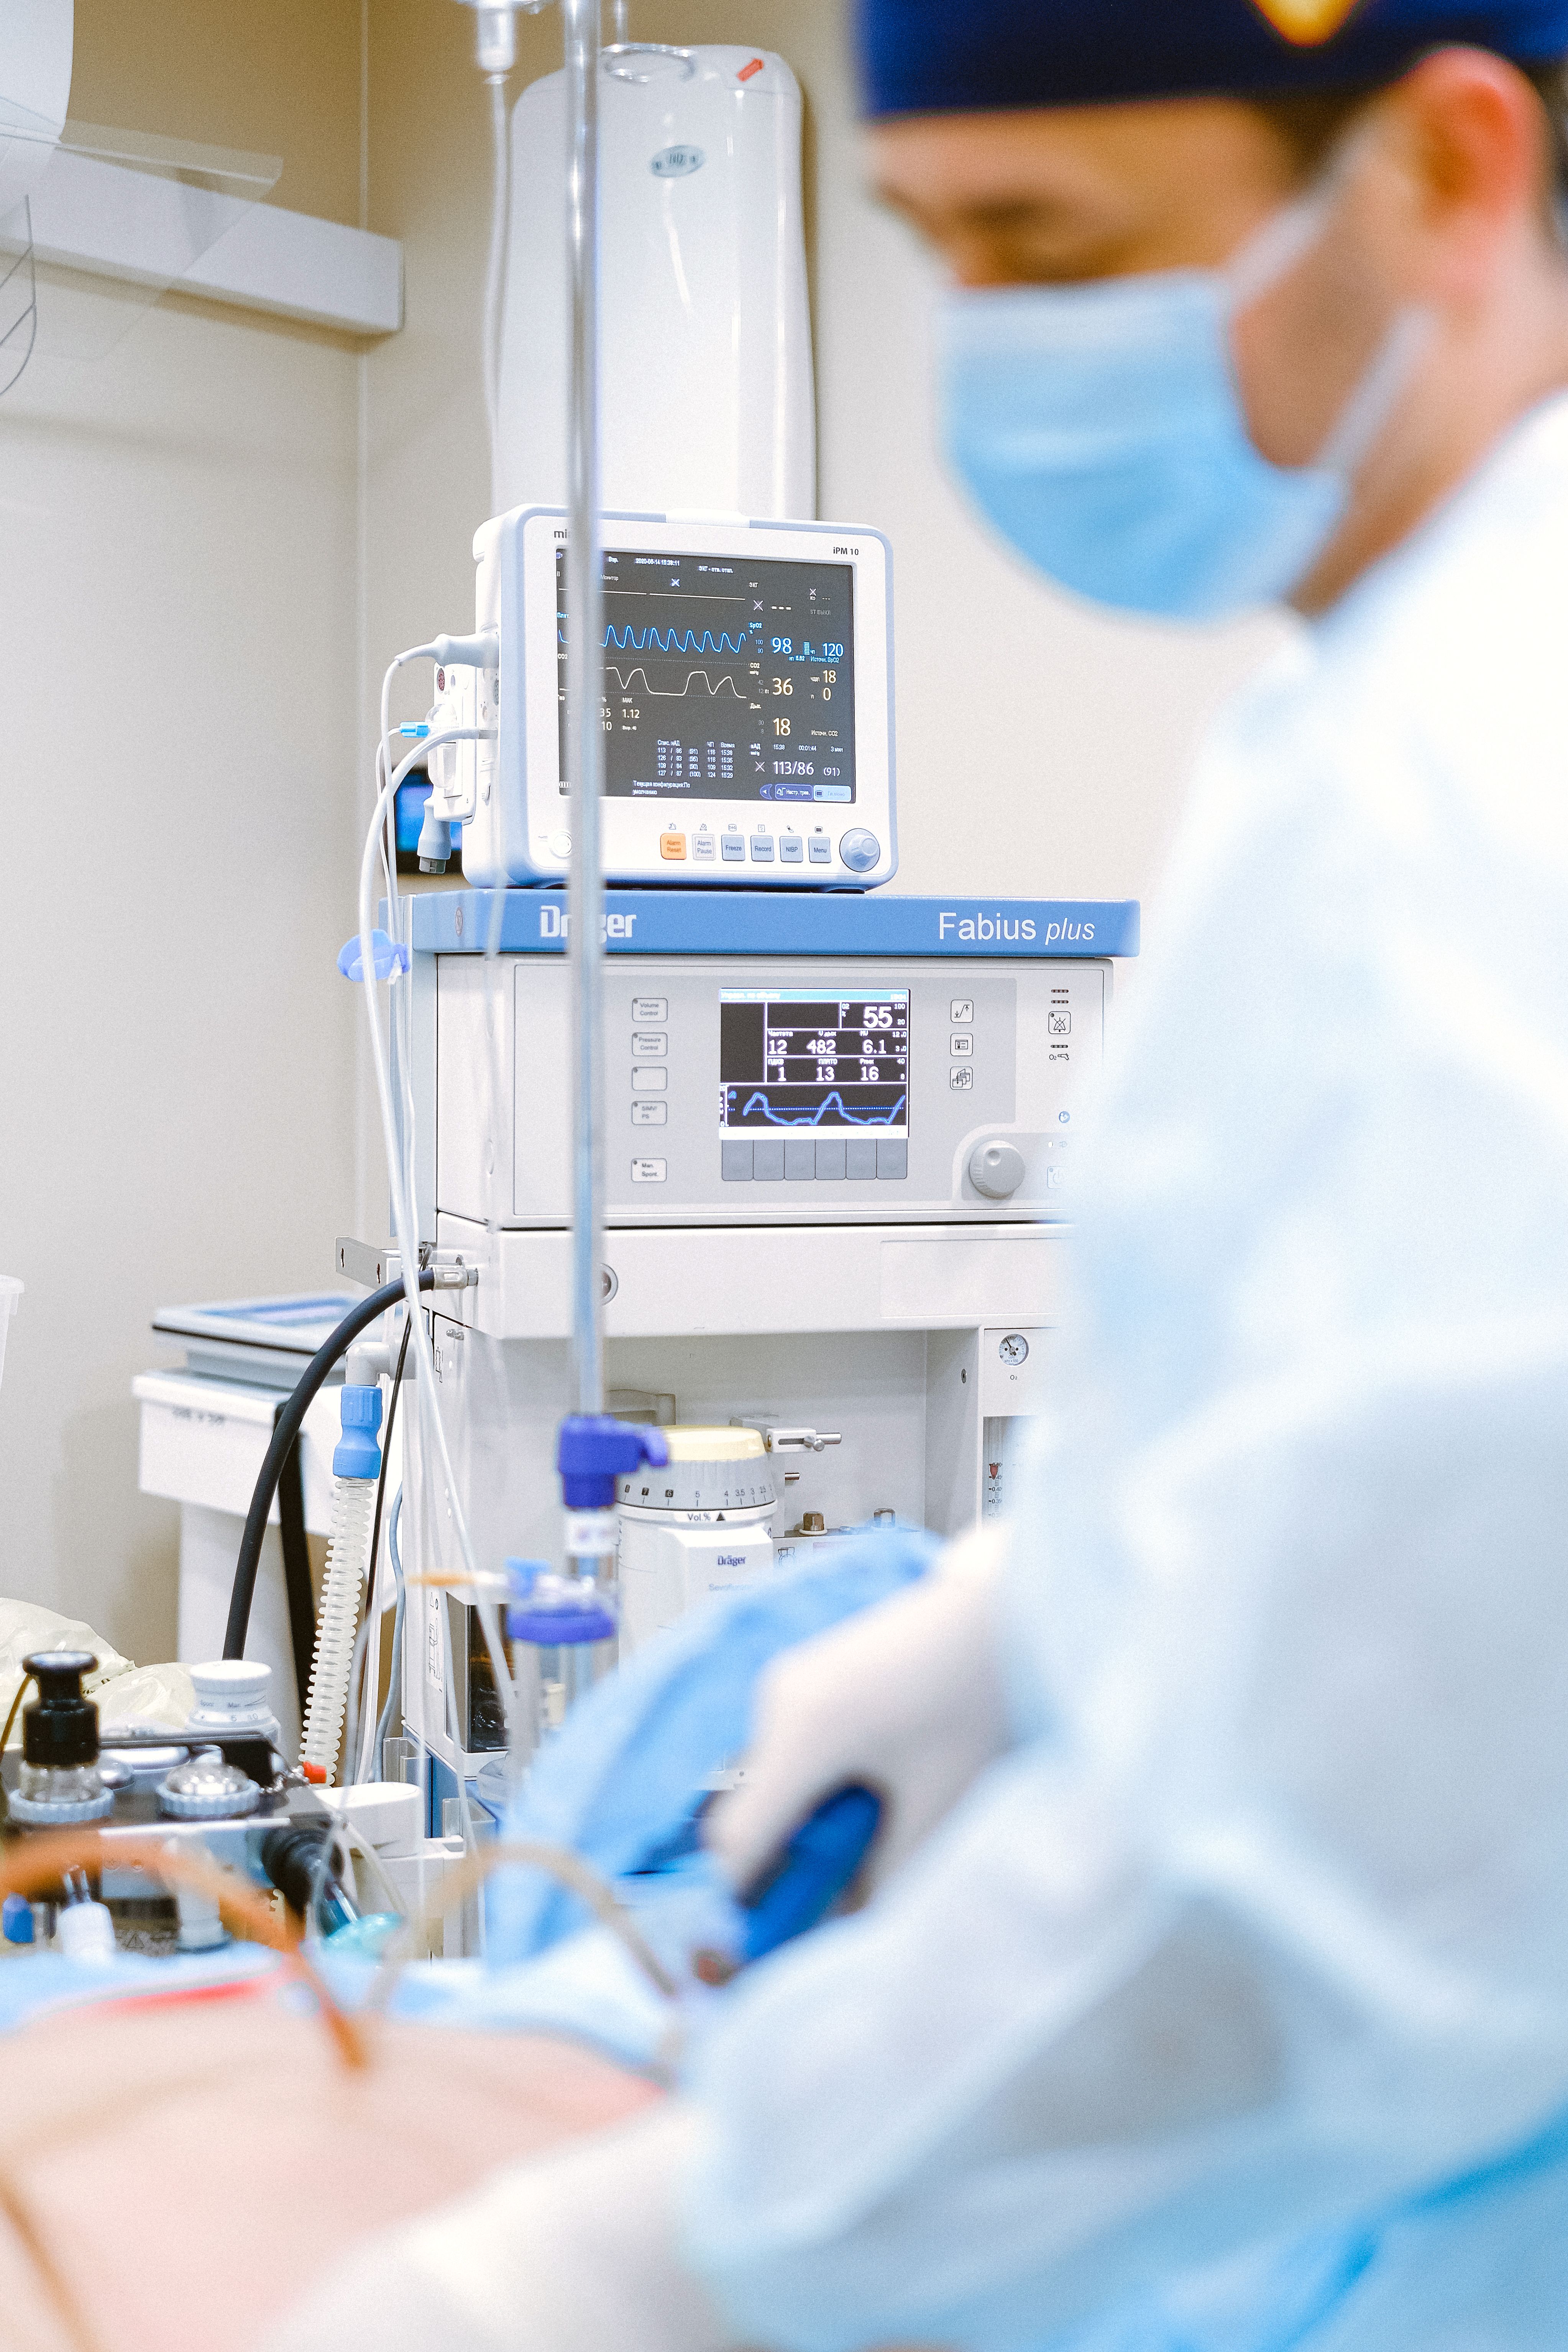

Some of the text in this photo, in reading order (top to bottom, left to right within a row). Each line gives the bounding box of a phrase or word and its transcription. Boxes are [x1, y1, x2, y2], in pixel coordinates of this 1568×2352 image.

[772, 637, 792, 654] 98
[823, 643, 843, 657] 120
[823, 670, 836, 683] 18
[773, 678, 793, 695] 36
[823, 688, 831, 701] 0
[622, 709, 639, 719] 1.12
[773, 718, 791, 736] 18
[773, 760, 840, 777] 113/86 (91)
[939, 912, 1095, 945] Fabius plus
[864, 1006, 893, 1028] 55
[769, 1040, 787, 1054] 12
[806, 1040, 836, 1054] 482
[863, 1039, 887, 1054] 6.1
[778, 1066, 786, 1081] 1
[816, 1066, 835, 1081] 13
[861, 1066, 879, 1081] 16
[718, 1555, 746, 1567] Dräger
